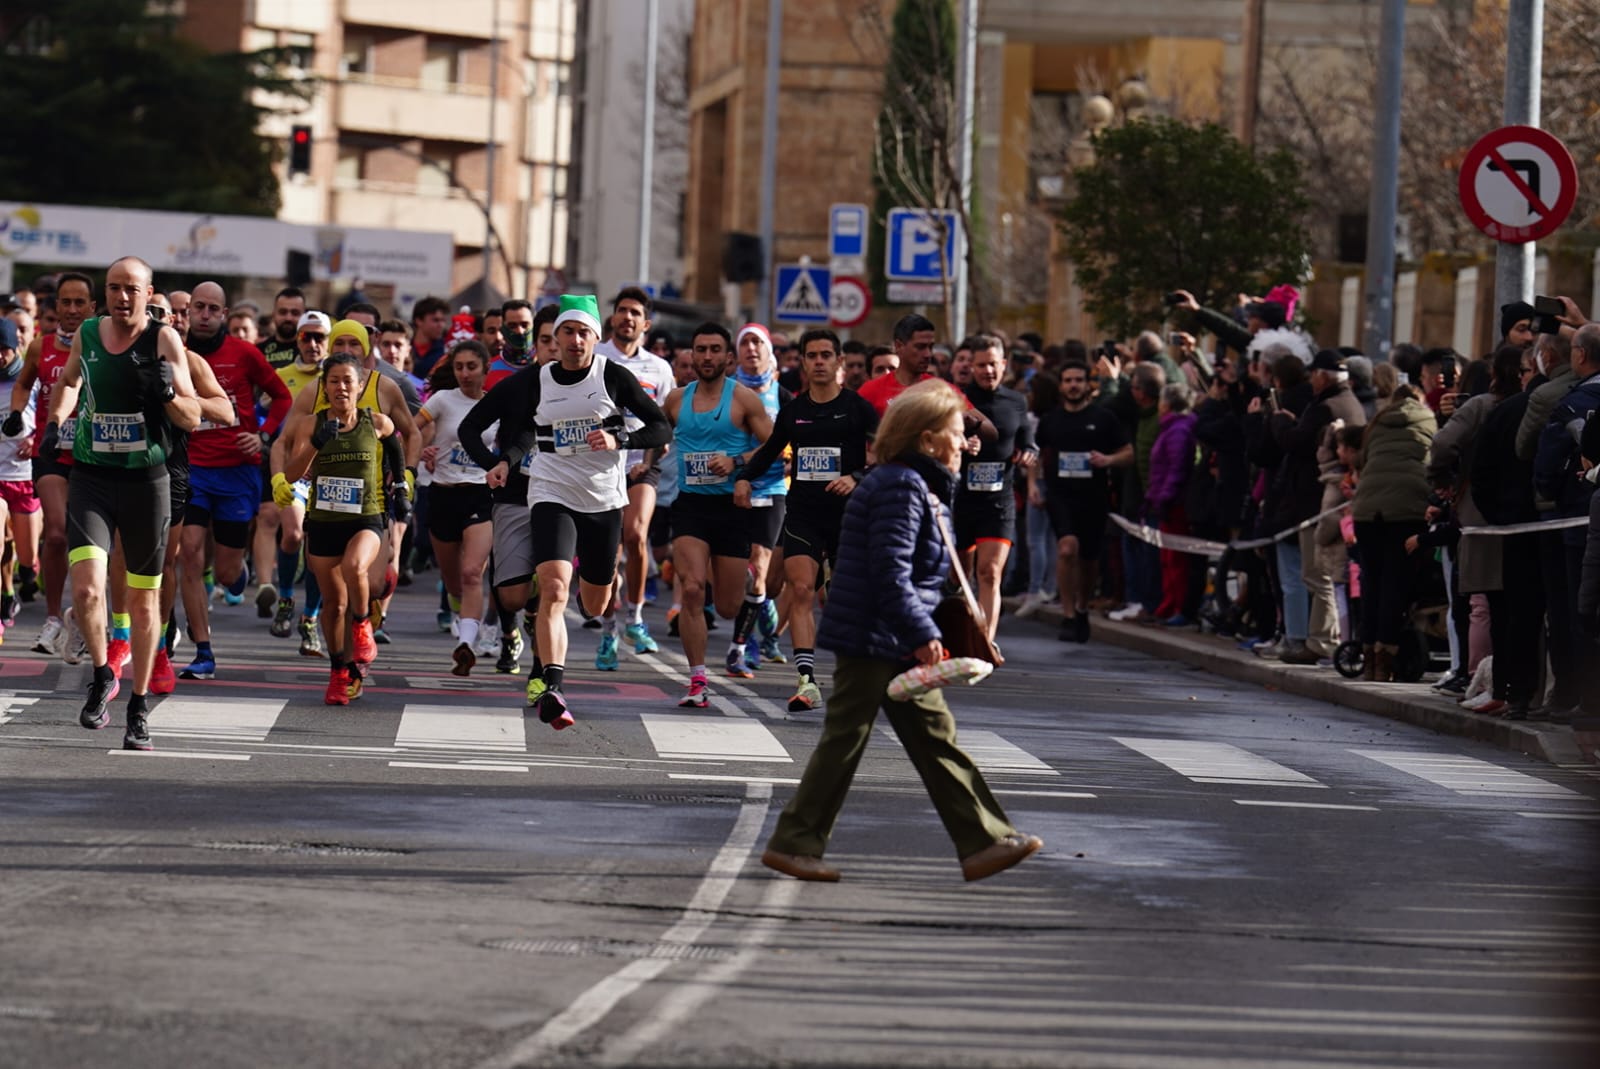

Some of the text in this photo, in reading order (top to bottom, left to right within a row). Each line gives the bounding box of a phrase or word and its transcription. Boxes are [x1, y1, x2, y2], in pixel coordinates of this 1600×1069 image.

[900, 217, 942, 271] P
[832, 293, 859, 311] 30
[100, 424, 131, 440] 3414
[331, 451, 371, 463] RUNNERS
[802, 456, 830, 470] 3403
[690, 461, 713, 475] 341
[322, 485, 352, 502] 3489
